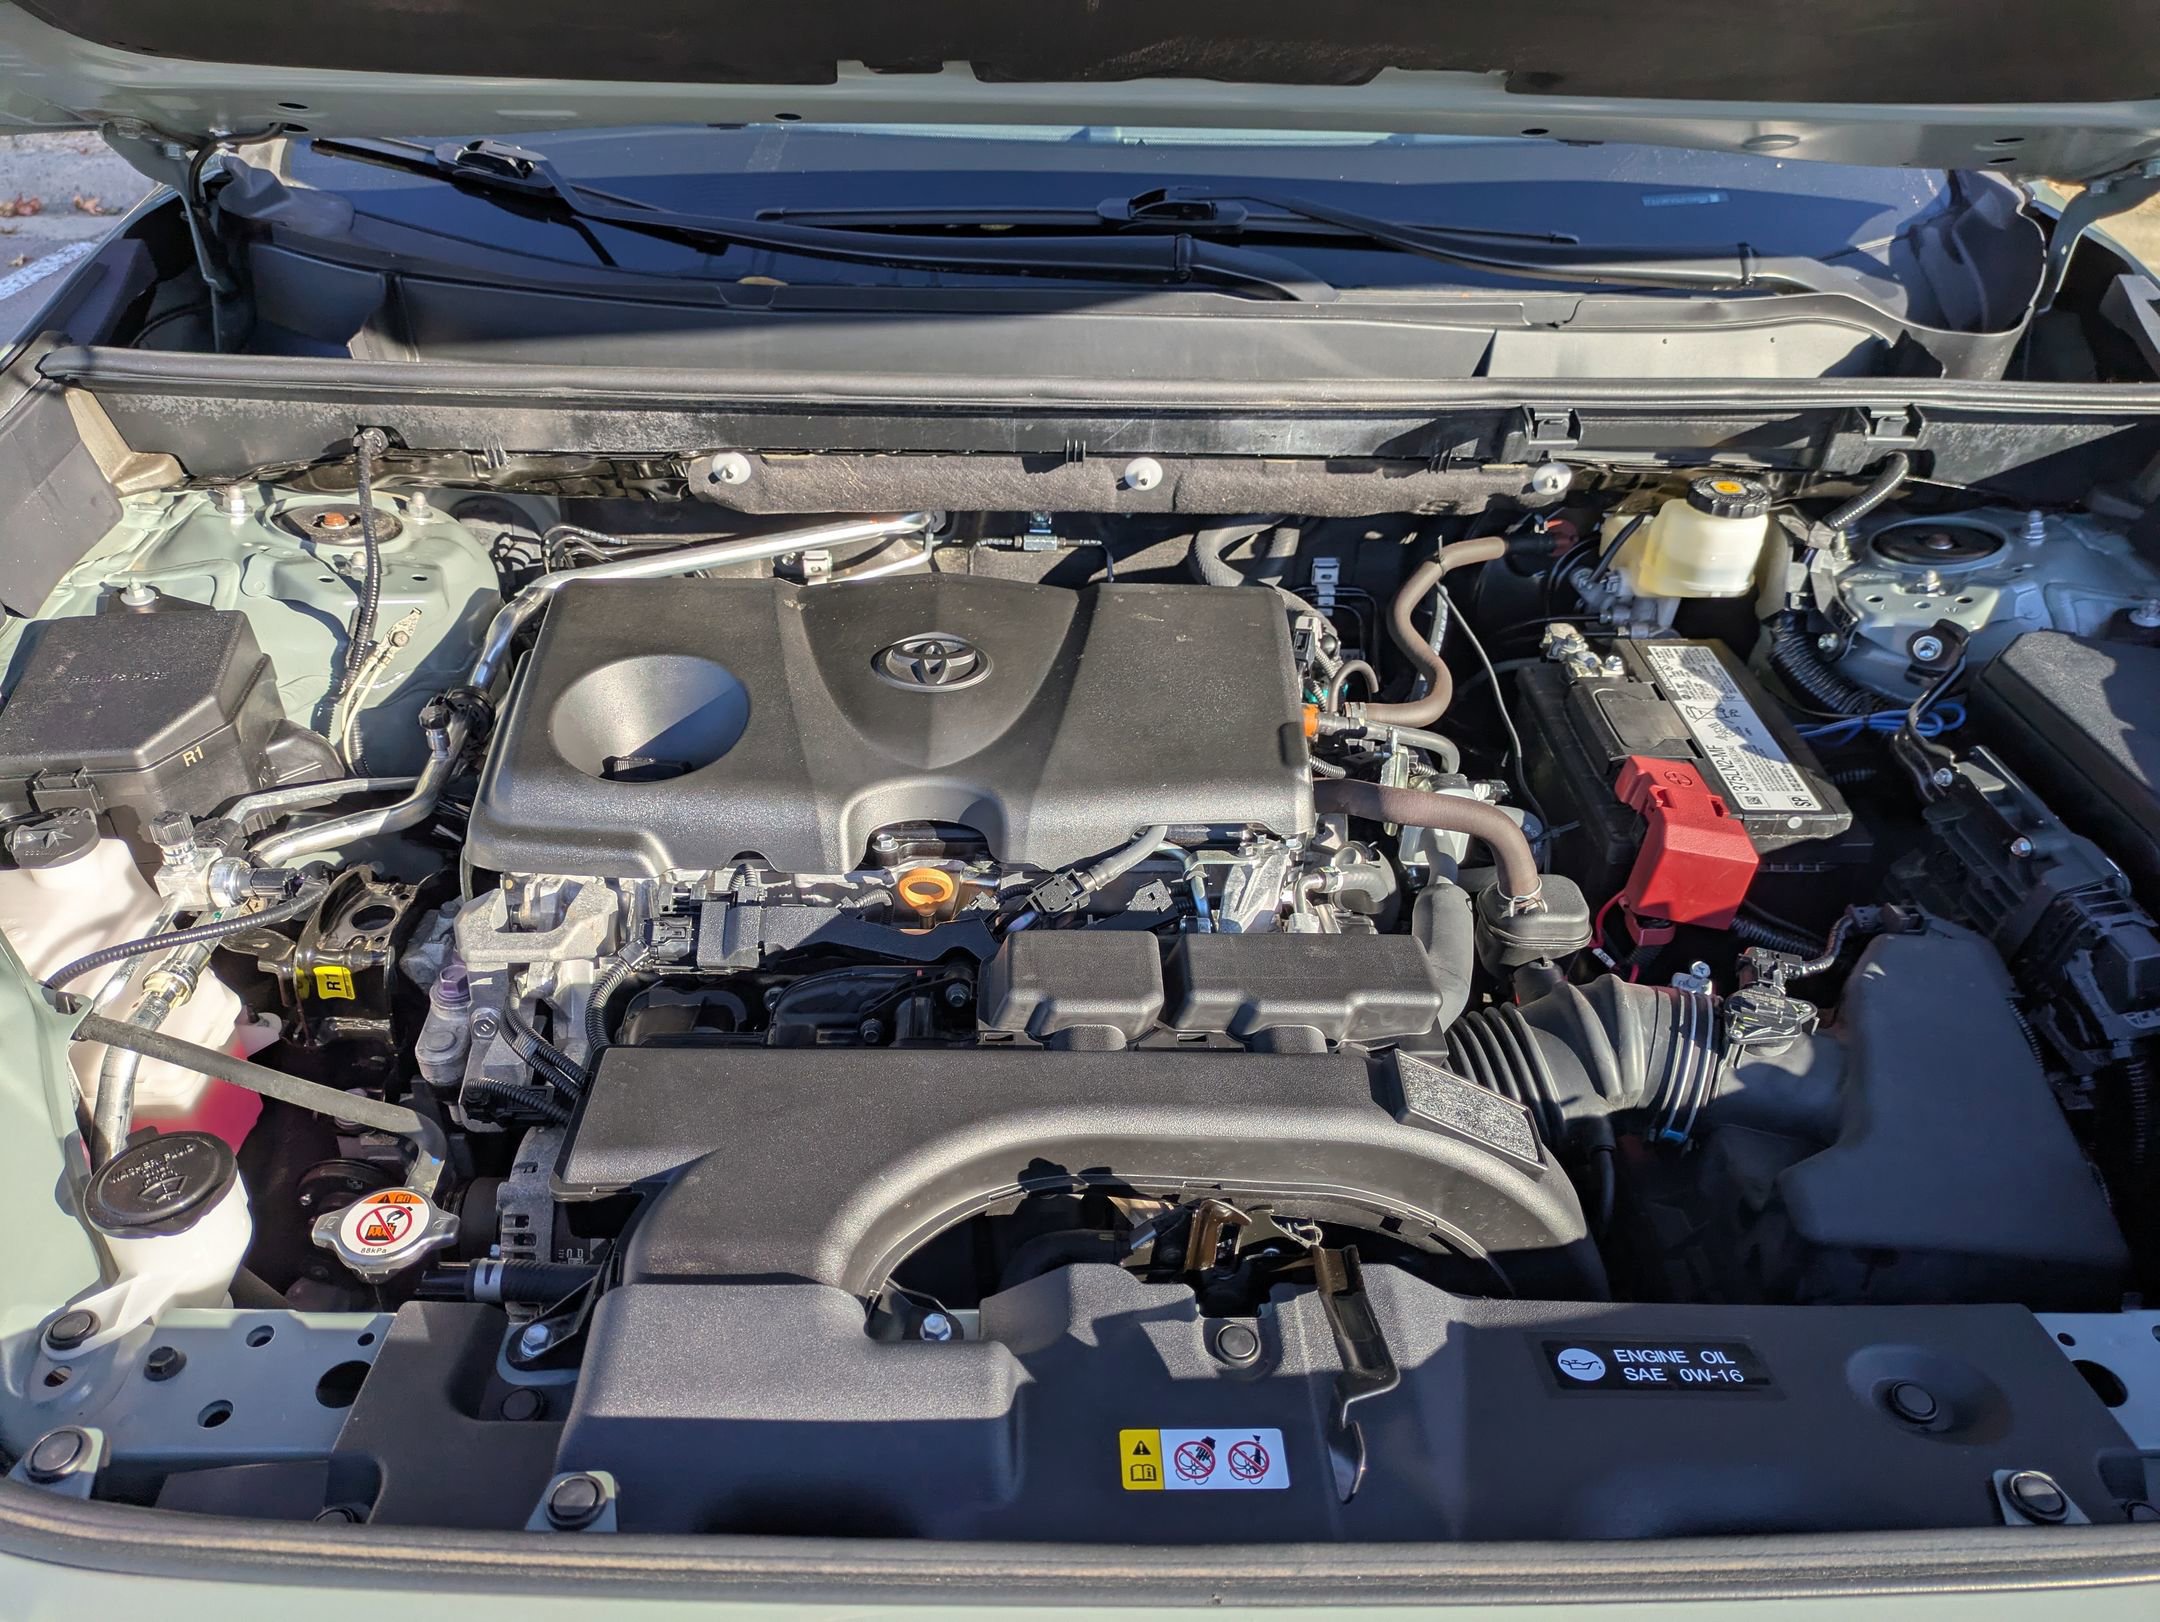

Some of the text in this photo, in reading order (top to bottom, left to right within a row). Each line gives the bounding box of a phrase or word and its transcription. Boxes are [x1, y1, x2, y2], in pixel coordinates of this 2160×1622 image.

[182, 746, 204, 767] R1
[1705, 744, 1750, 792] 375LN2-MF
[1791, 796, 1812, 807] SP
[324, 973, 342, 991] R1
[1613, 1349, 1736, 1365] ENGINE OIL
[1623, 1367, 1745, 1383] SAE 0W-16
